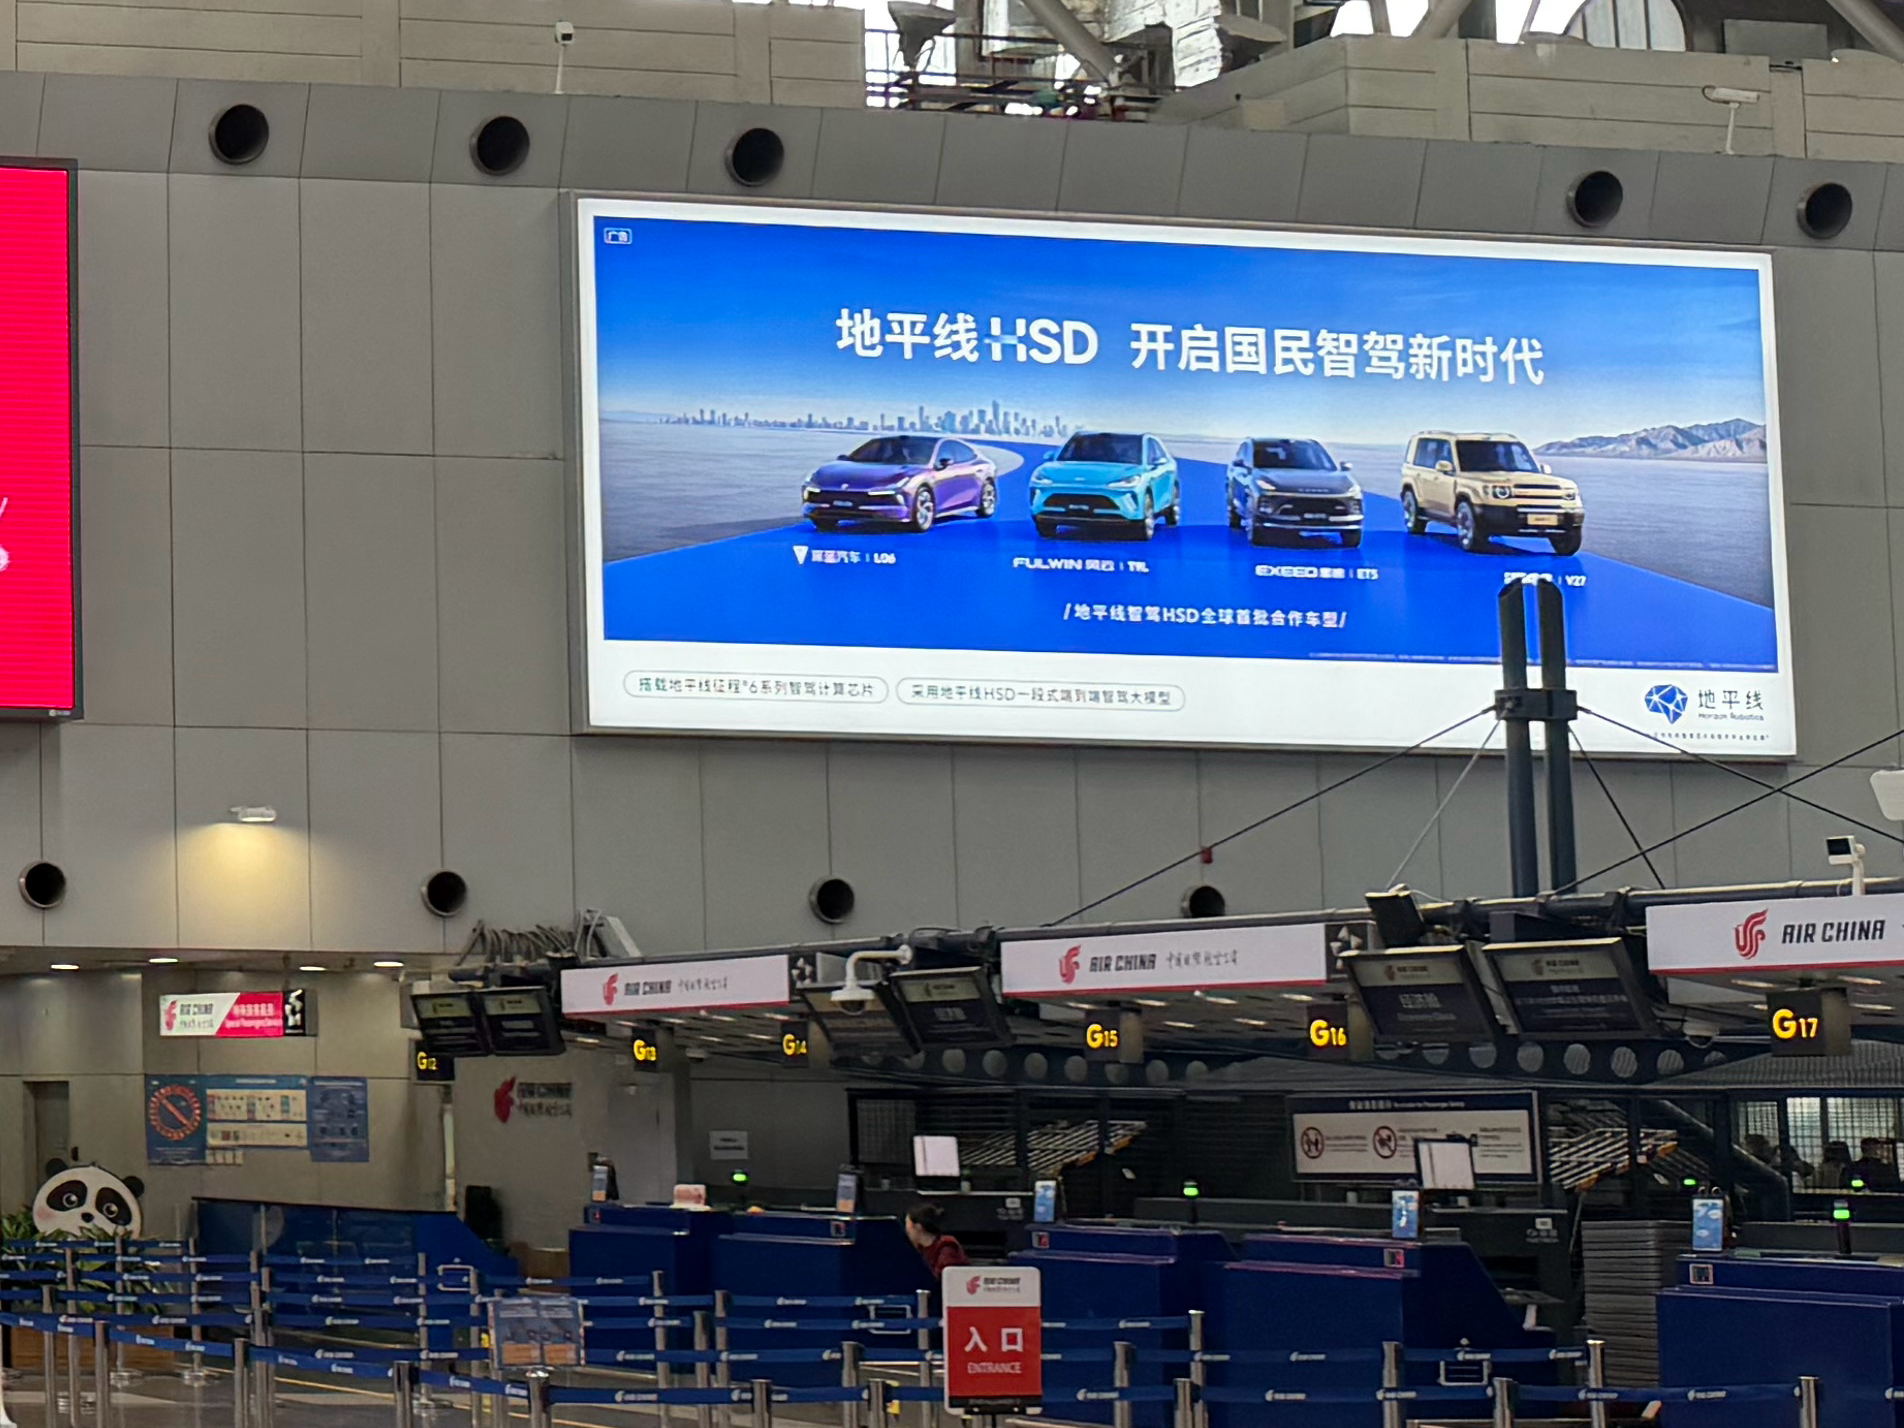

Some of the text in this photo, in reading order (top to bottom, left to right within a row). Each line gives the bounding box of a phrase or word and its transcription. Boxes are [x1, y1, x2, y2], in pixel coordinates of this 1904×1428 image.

[1130, 322, 1545, 385] 开启国民智驾新时代
[1013, 557, 1082, 570] FULWIN
[1698, 690, 1764, 711] 地平线
[1782, 920, 1886, 944] AIR CHINA
[1089, 954, 1157, 972] AIR CHINA
[1310, 1019, 1346, 1047] G16
[1773, 1009, 1819, 1039] G17
[1086, 1024, 1118, 1049] G15
[964, 1326, 1023, 1352] 入口
[968, 1361, 1023, 1373] ENTRANCE
